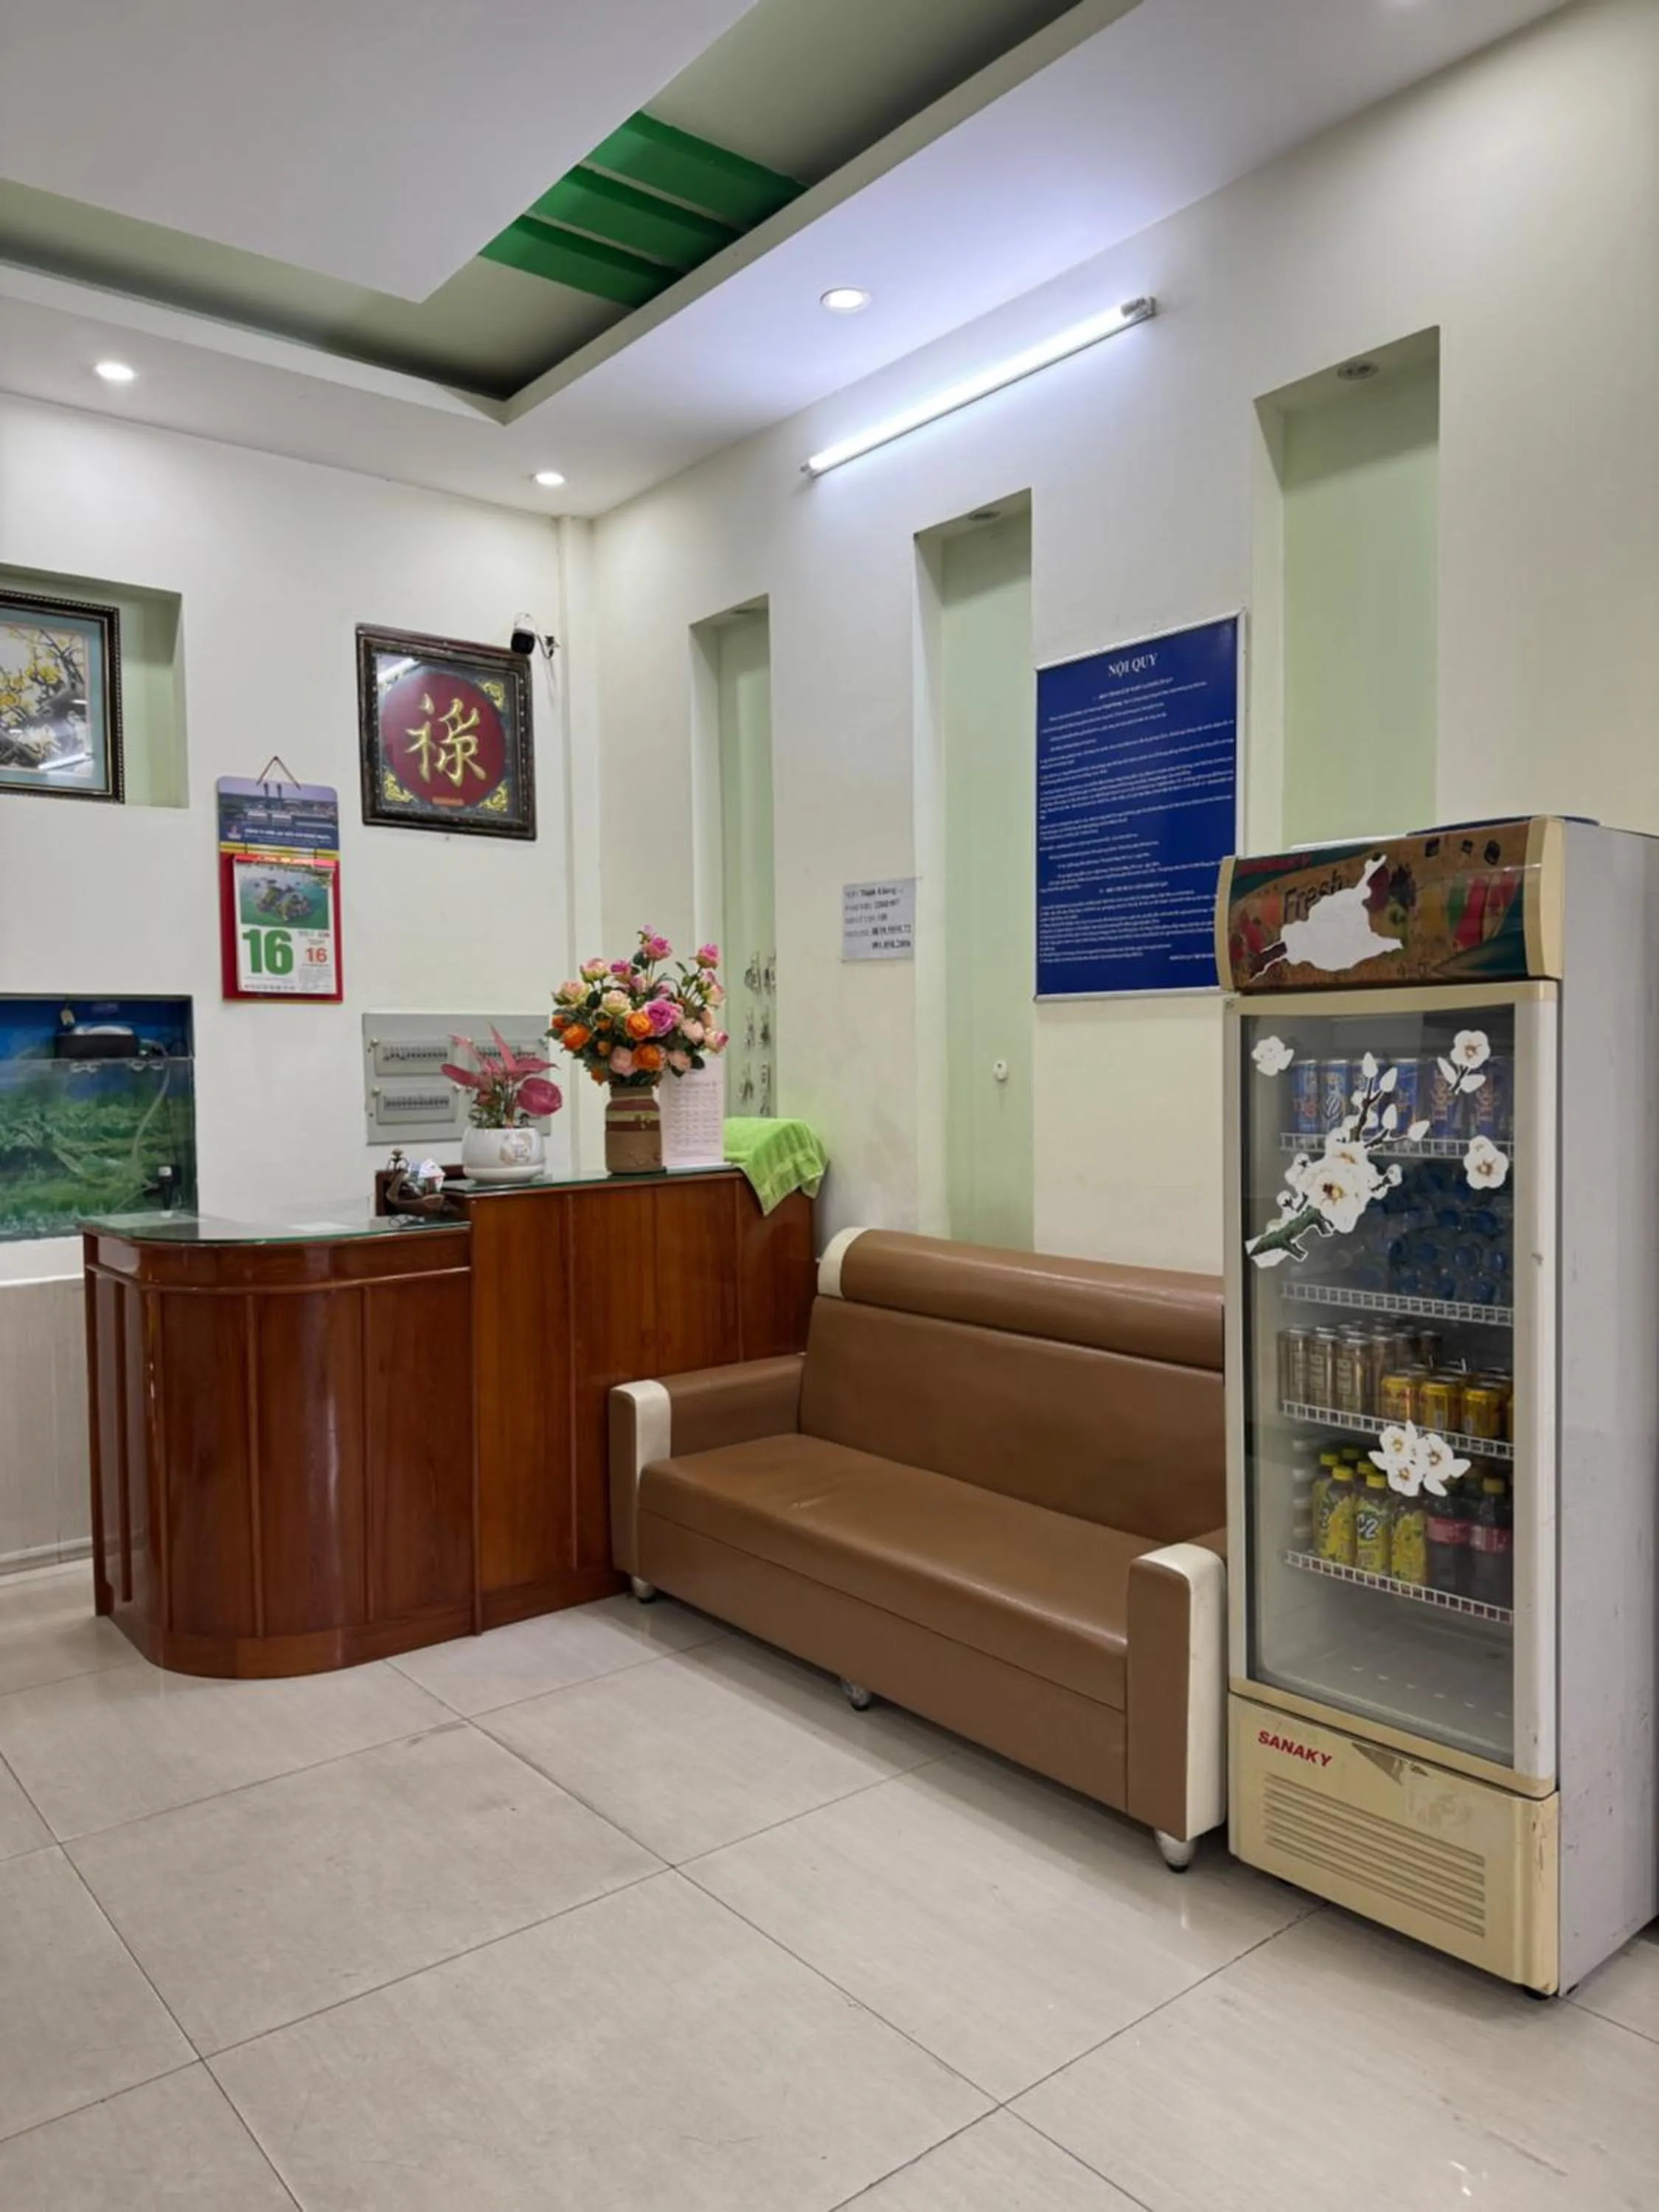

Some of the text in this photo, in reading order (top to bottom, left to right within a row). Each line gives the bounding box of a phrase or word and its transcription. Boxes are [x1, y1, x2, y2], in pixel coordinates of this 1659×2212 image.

[1132, 653, 1159, 672] QUY
[243, 929, 293, 975] 16
[305, 947, 328, 963] 16
[1258, 1730, 1333, 1768] SANAKY
